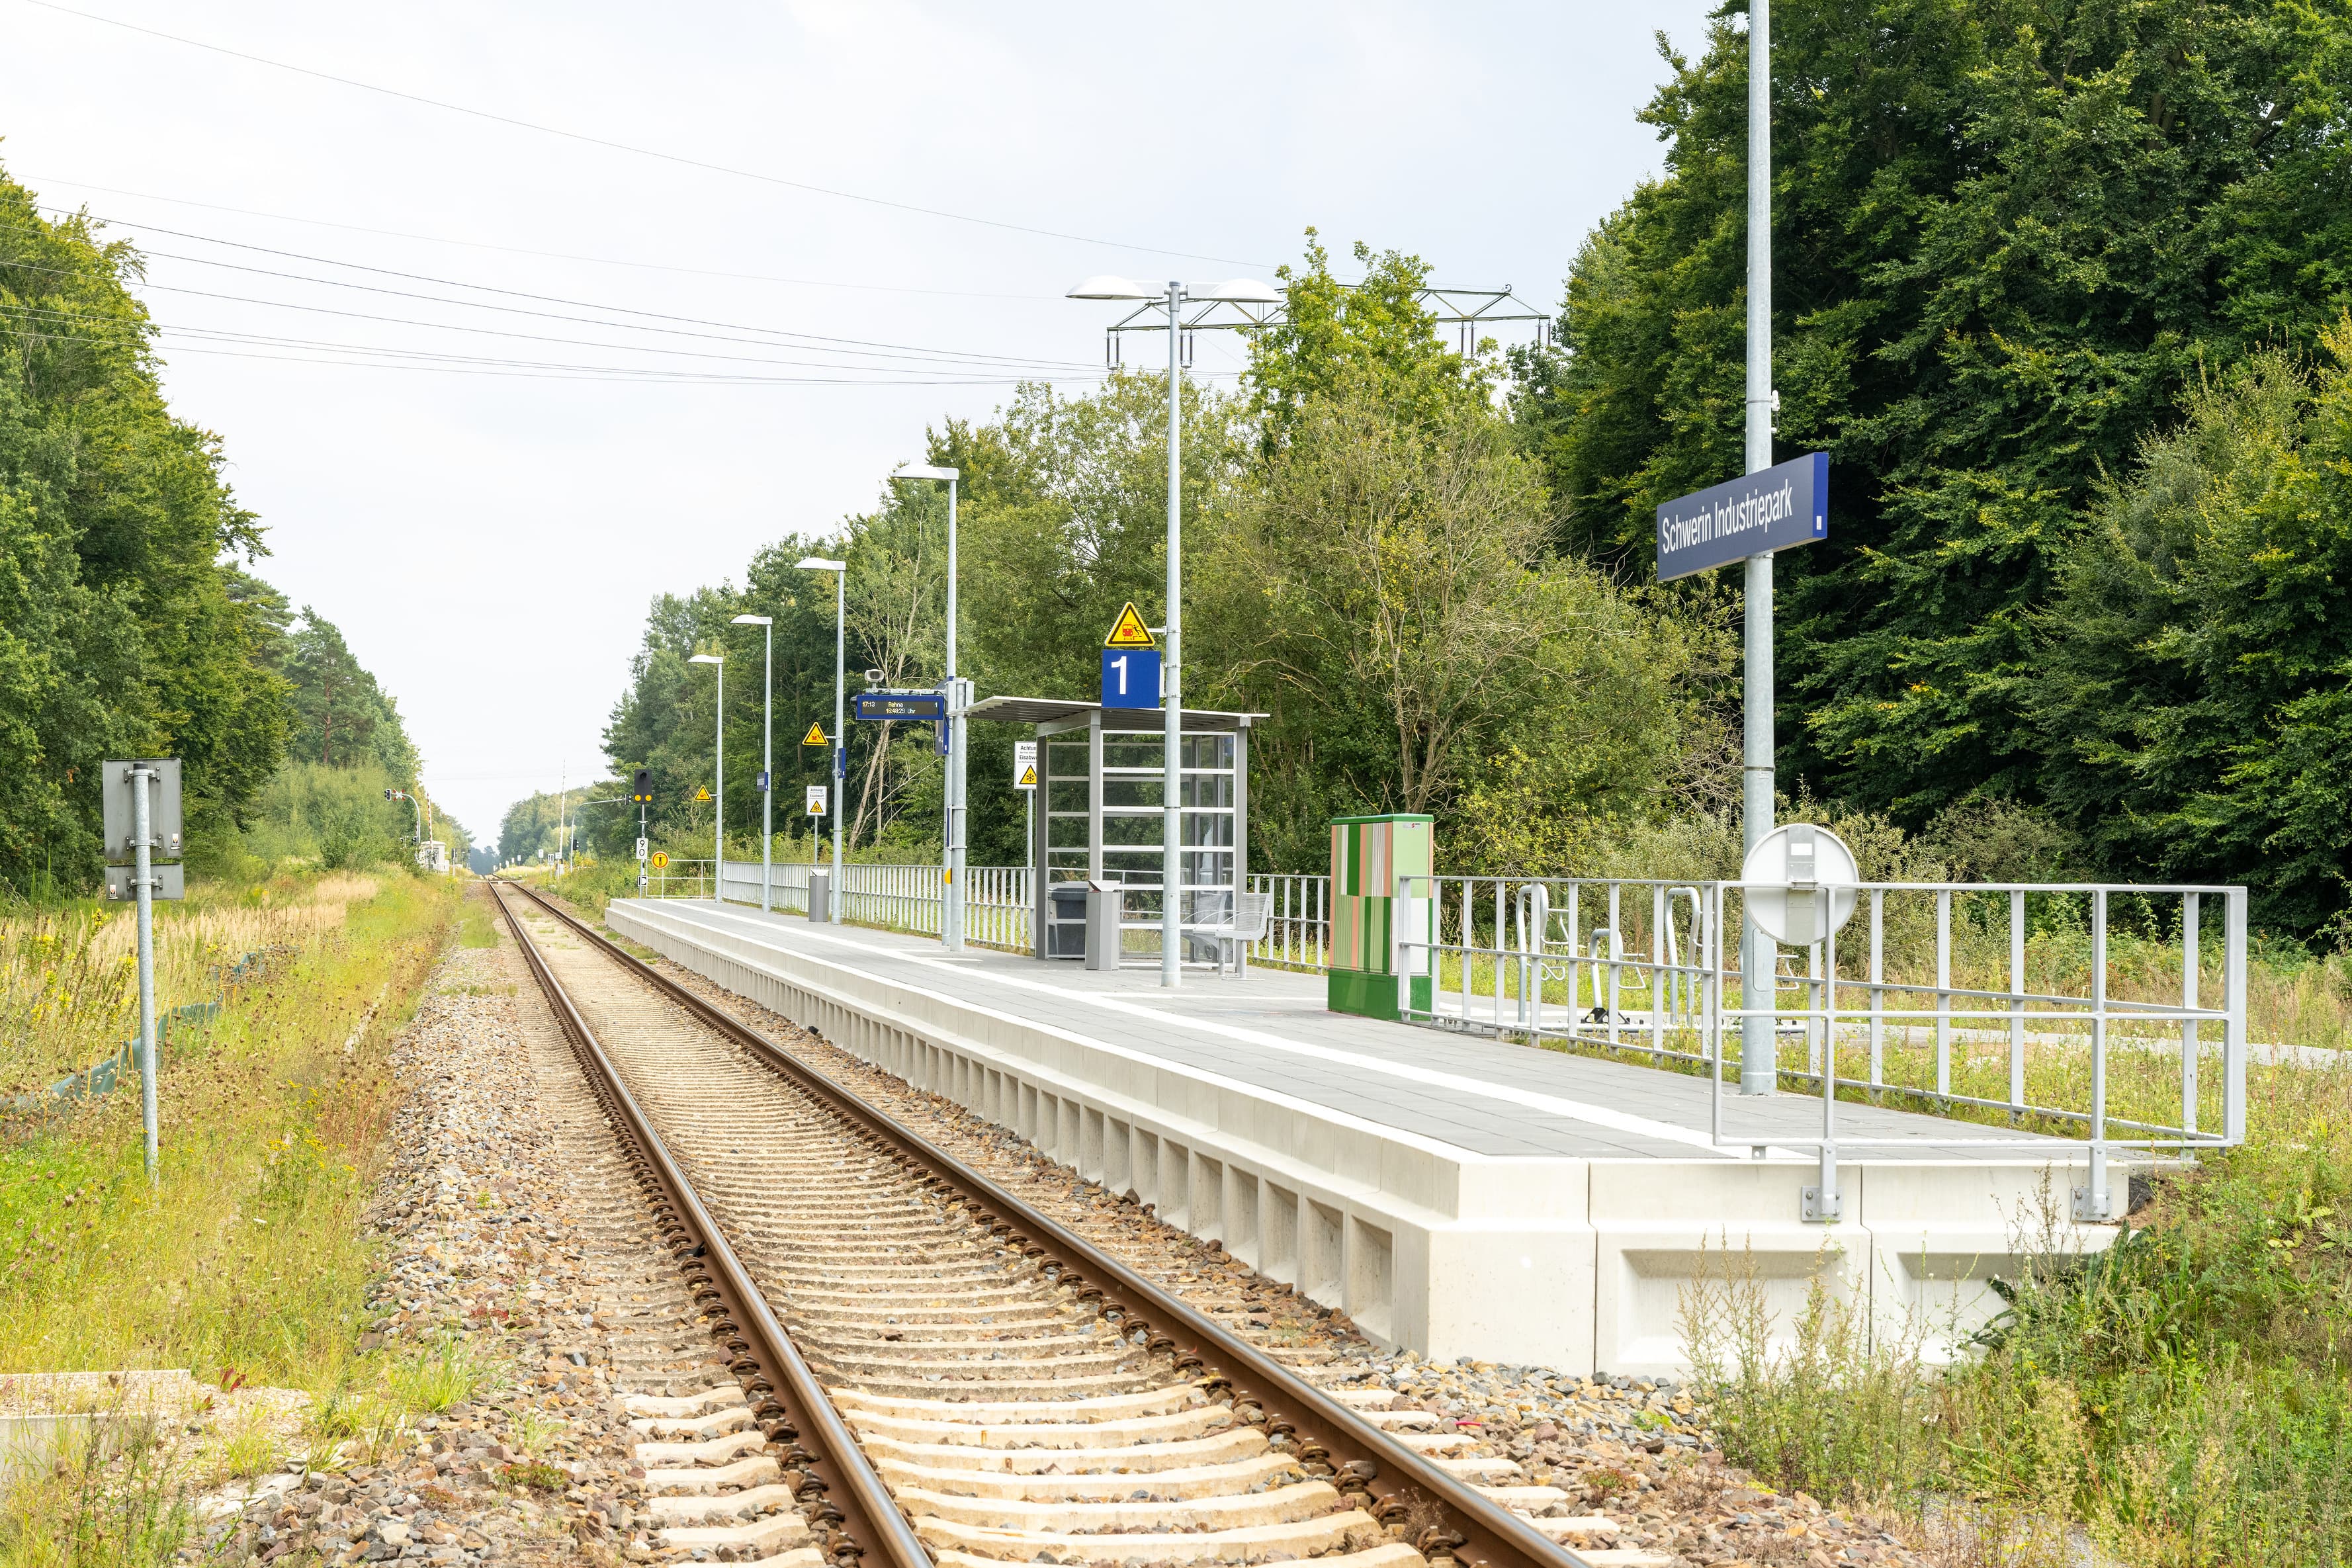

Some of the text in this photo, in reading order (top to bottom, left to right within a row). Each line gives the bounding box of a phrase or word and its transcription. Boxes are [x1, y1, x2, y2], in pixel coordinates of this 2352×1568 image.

[1662, 478, 1793, 554] Schwerin Industriepark
[1111, 656, 1127, 695] 1
